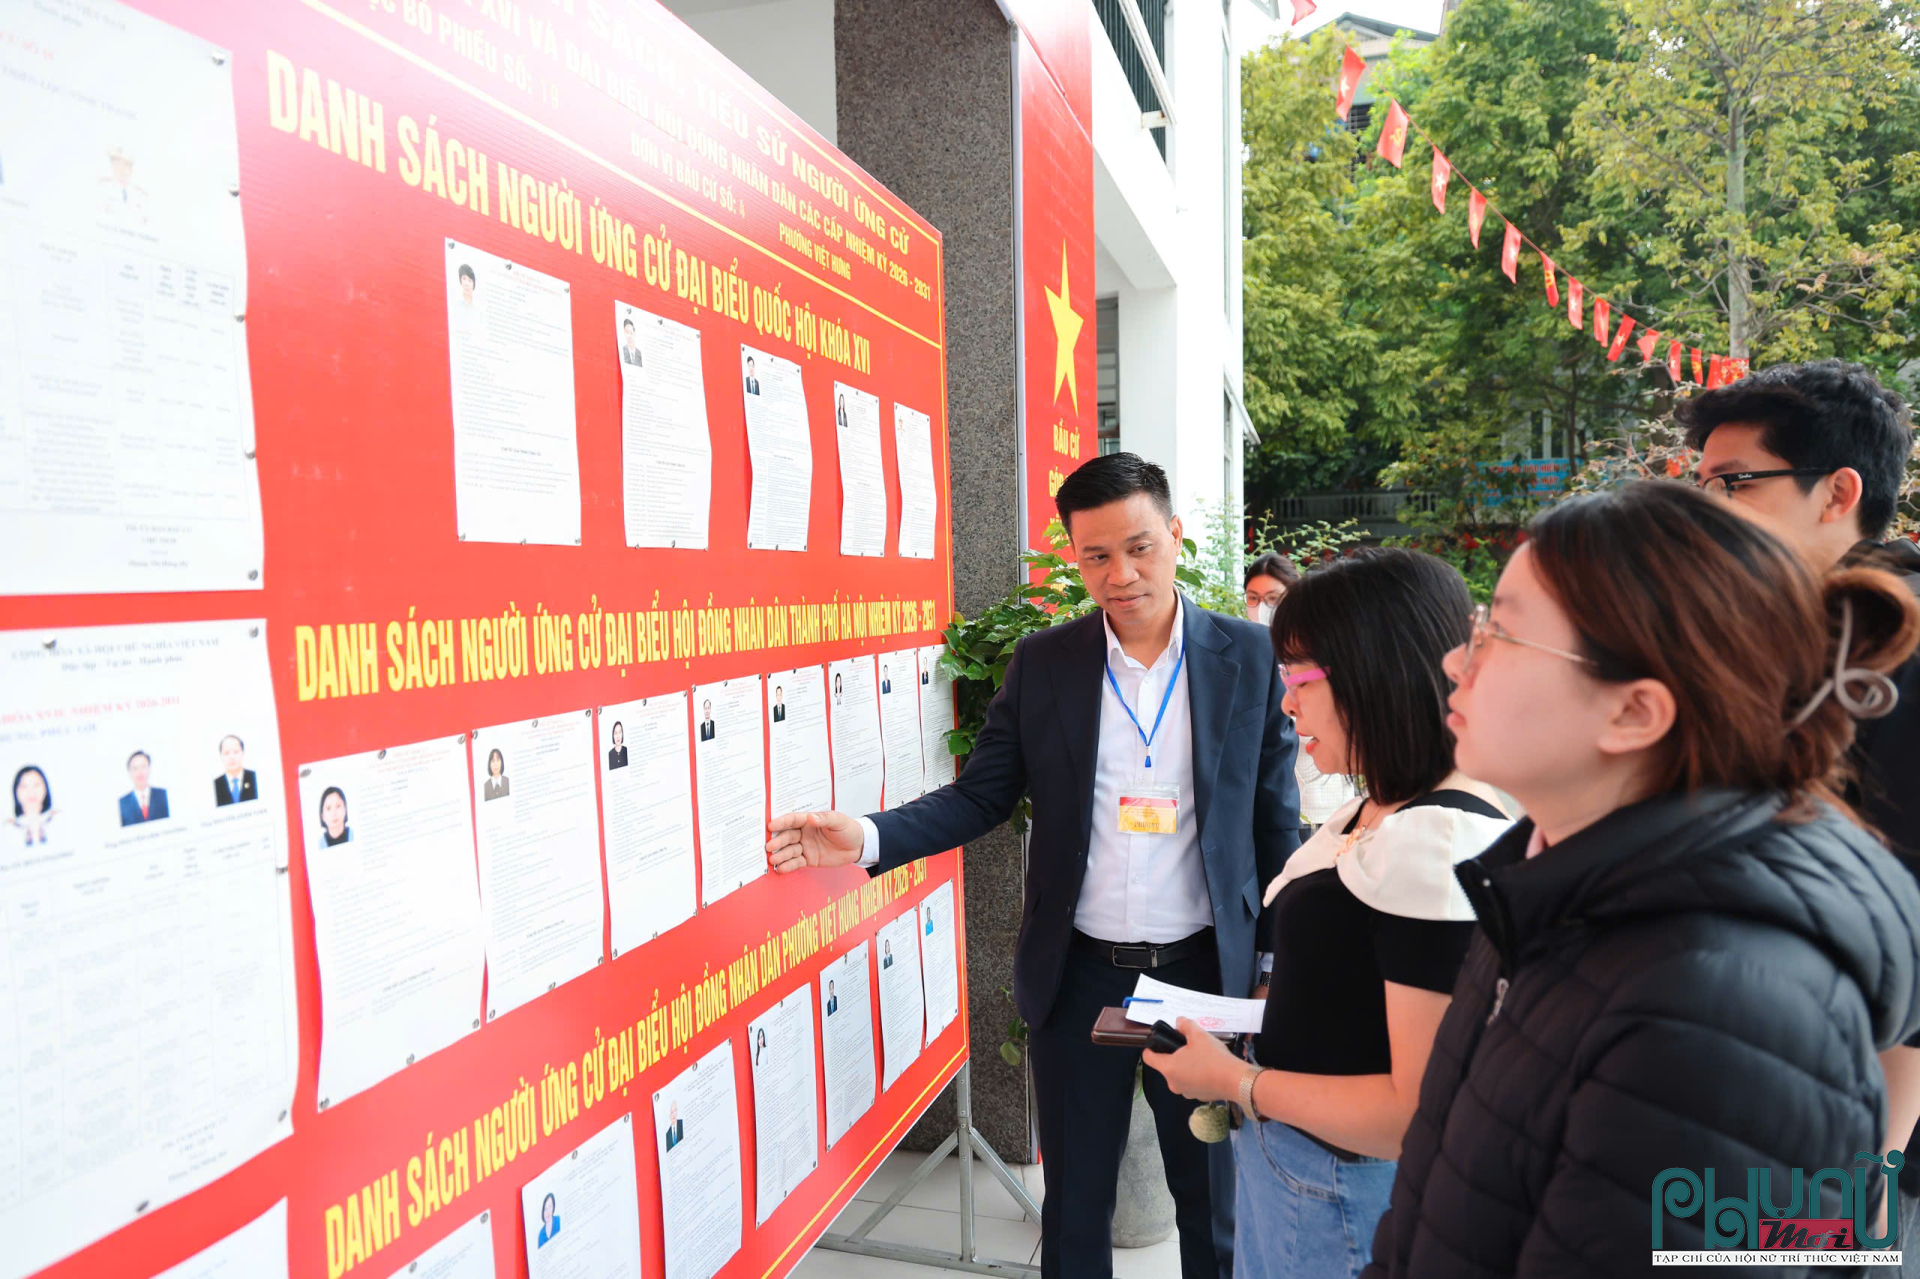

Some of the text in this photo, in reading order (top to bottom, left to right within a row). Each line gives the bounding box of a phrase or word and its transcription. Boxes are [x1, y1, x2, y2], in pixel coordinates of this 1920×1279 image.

[438, 12, 498, 73] PHIẾU
[267, 48, 871, 375] DANH SÁCH NGƯỜI ỨNG CỬ ĐẠI BIỂU QUỐC HỘI KHÓA XVI
[528, 14, 559, 60] VÀ
[606, 67, 649, 119] BIỂU
[685, 122, 728, 171] ĐỒNG
[731, 152, 769, 197] NHÂN
[771, 181, 797, 215] DÂN
[799, 202, 821, 231] CÁC
[823, 215, 844, 243] CẤP
[845, 229, 875, 266] NHIỆM
[876, 250, 887, 273] KỲ
[889, 260, 908, 287] 2026
[914, 276, 931, 302] 2031
[676, 158, 700, 192] BẦU
[701, 173, 718, 203] CỬ
[719, 184, 737, 214] SỐ:
[693, 77, 748, 140] TIỂU
[757, 124, 788, 167] SỬ
[792, 157, 849, 213] NGƯỜI
[854, 194, 886, 242] ỨNG
[889, 226, 910, 255] CỬ
[778, 221, 852, 281] PHƯỜNG VIỆT HƯNG
[1070, 425, 1080, 460] CỬ
[295, 622, 380, 702] DANH
[385, 605, 456, 693] SÁCH
[460, 601, 529, 684] NGƯỜI
[532, 602, 574, 675] ỨNG
[577, 593, 602, 671] CỬ
[605, 611, 634, 678] ĐẠI
[636, 589, 670, 664] BIỂU
[672, 598, 696, 670] HỘI
[697, 592, 732, 658] ĐỒNG
[733, 597, 765, 652] NHÂN
[766, 596, 788, 649] DÂN
[789, 595, 821, 646] THÀNH
[822, 589, 839, 643] PHỐ
[840, 597, 852, 641] HÀ
[853, 594, 867, 646] NỘI
[868, 594, 892, 644] NHIỆM
[892, 594, 901, 635] KỲ
[902, 600, 917, 633] 2026
[922, 599, 936, 630] 2031
[325, 1167, 401, 1279] DANH
[406, 1131, 470, 1229] SÁCH
[474, 1076, 537, 1184] NGƯỜI
[541, 1062, 579, 1138] ỨNG
[582, 1025, 605, 1110] CỬ
[607, 1025, 635, 1097] ĐẠI
[636, 988, 669, 1075] BIỂU
[671, 982, 693, 1055] HỘI
[694, 962, 728, 1034] ĐỒNG
[728, 944, 759, 1010] NHÂN
[759, 931, 782, 989] DÂN
[781, 909, 819, 974] PHƯỜNG
[819, 895, 838, 952] VIỆT
[838, 887, 860, 939] HƯNG
[893, 863, 909, 900] 2026
[913, 856, 927, 887] 2031
